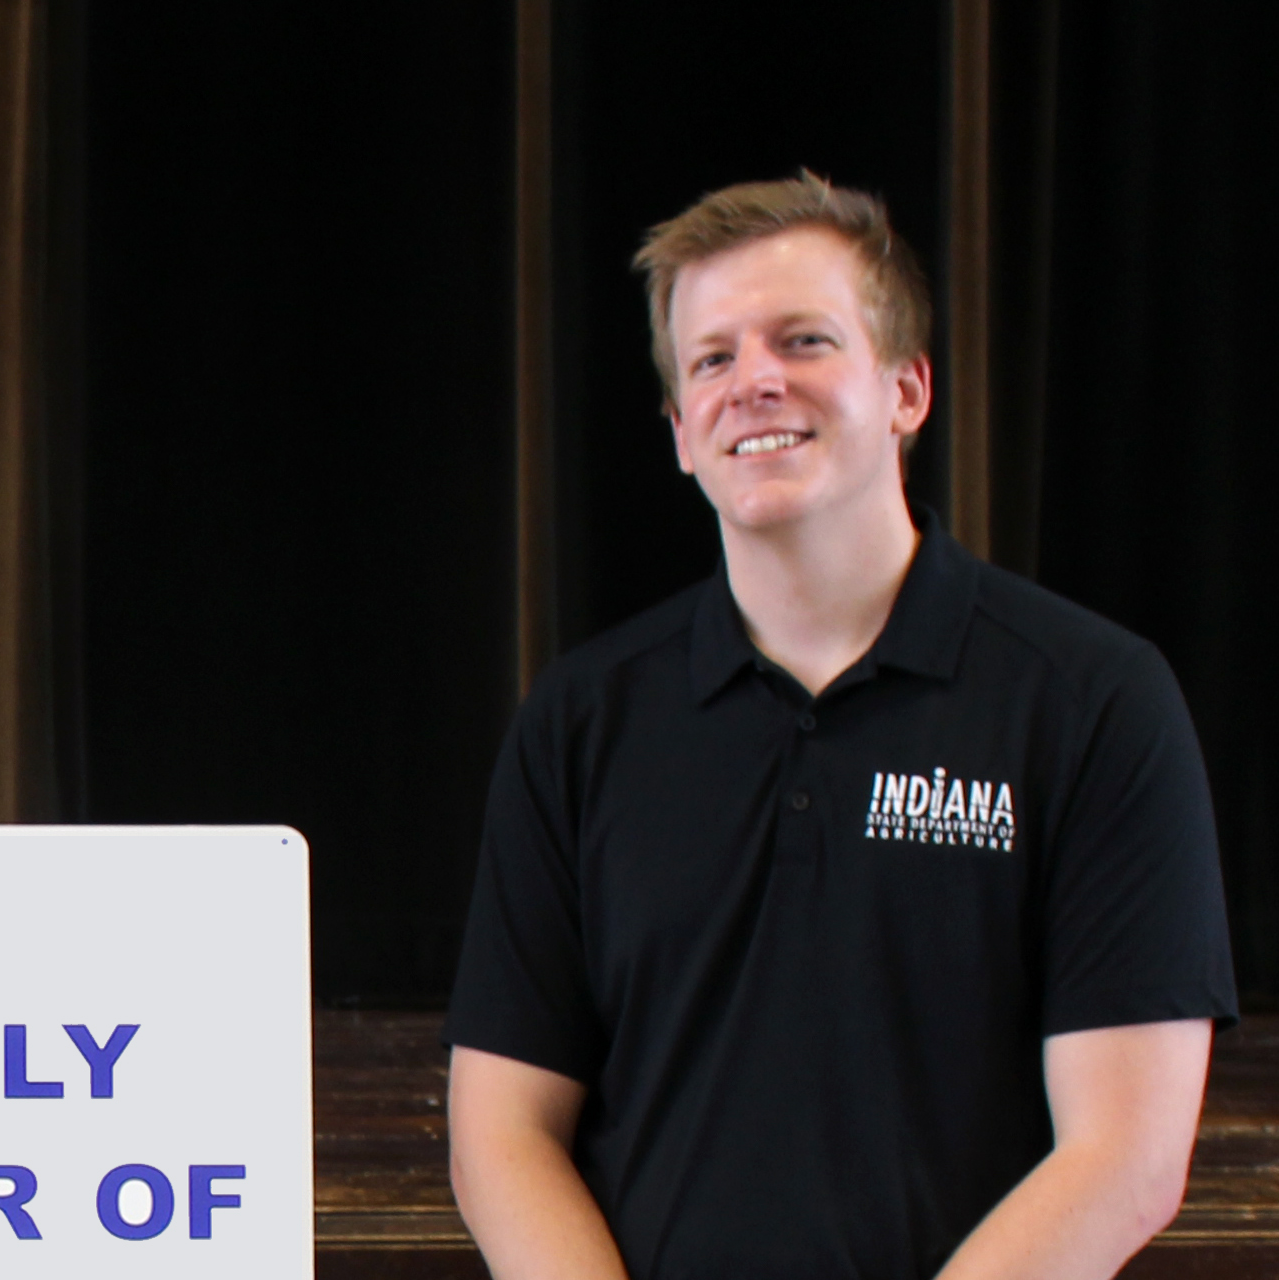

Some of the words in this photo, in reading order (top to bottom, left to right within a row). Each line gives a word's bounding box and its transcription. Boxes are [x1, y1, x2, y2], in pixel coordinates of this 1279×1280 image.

[866, 812, 906, 827] STATE
[910, 816, 994, 835] DEPARTMENT
[997, 824, 1016, 839] OF
[864, 826, 1013, 853] AGRICULTURE
[96, 1164, 246, 1241] OF
